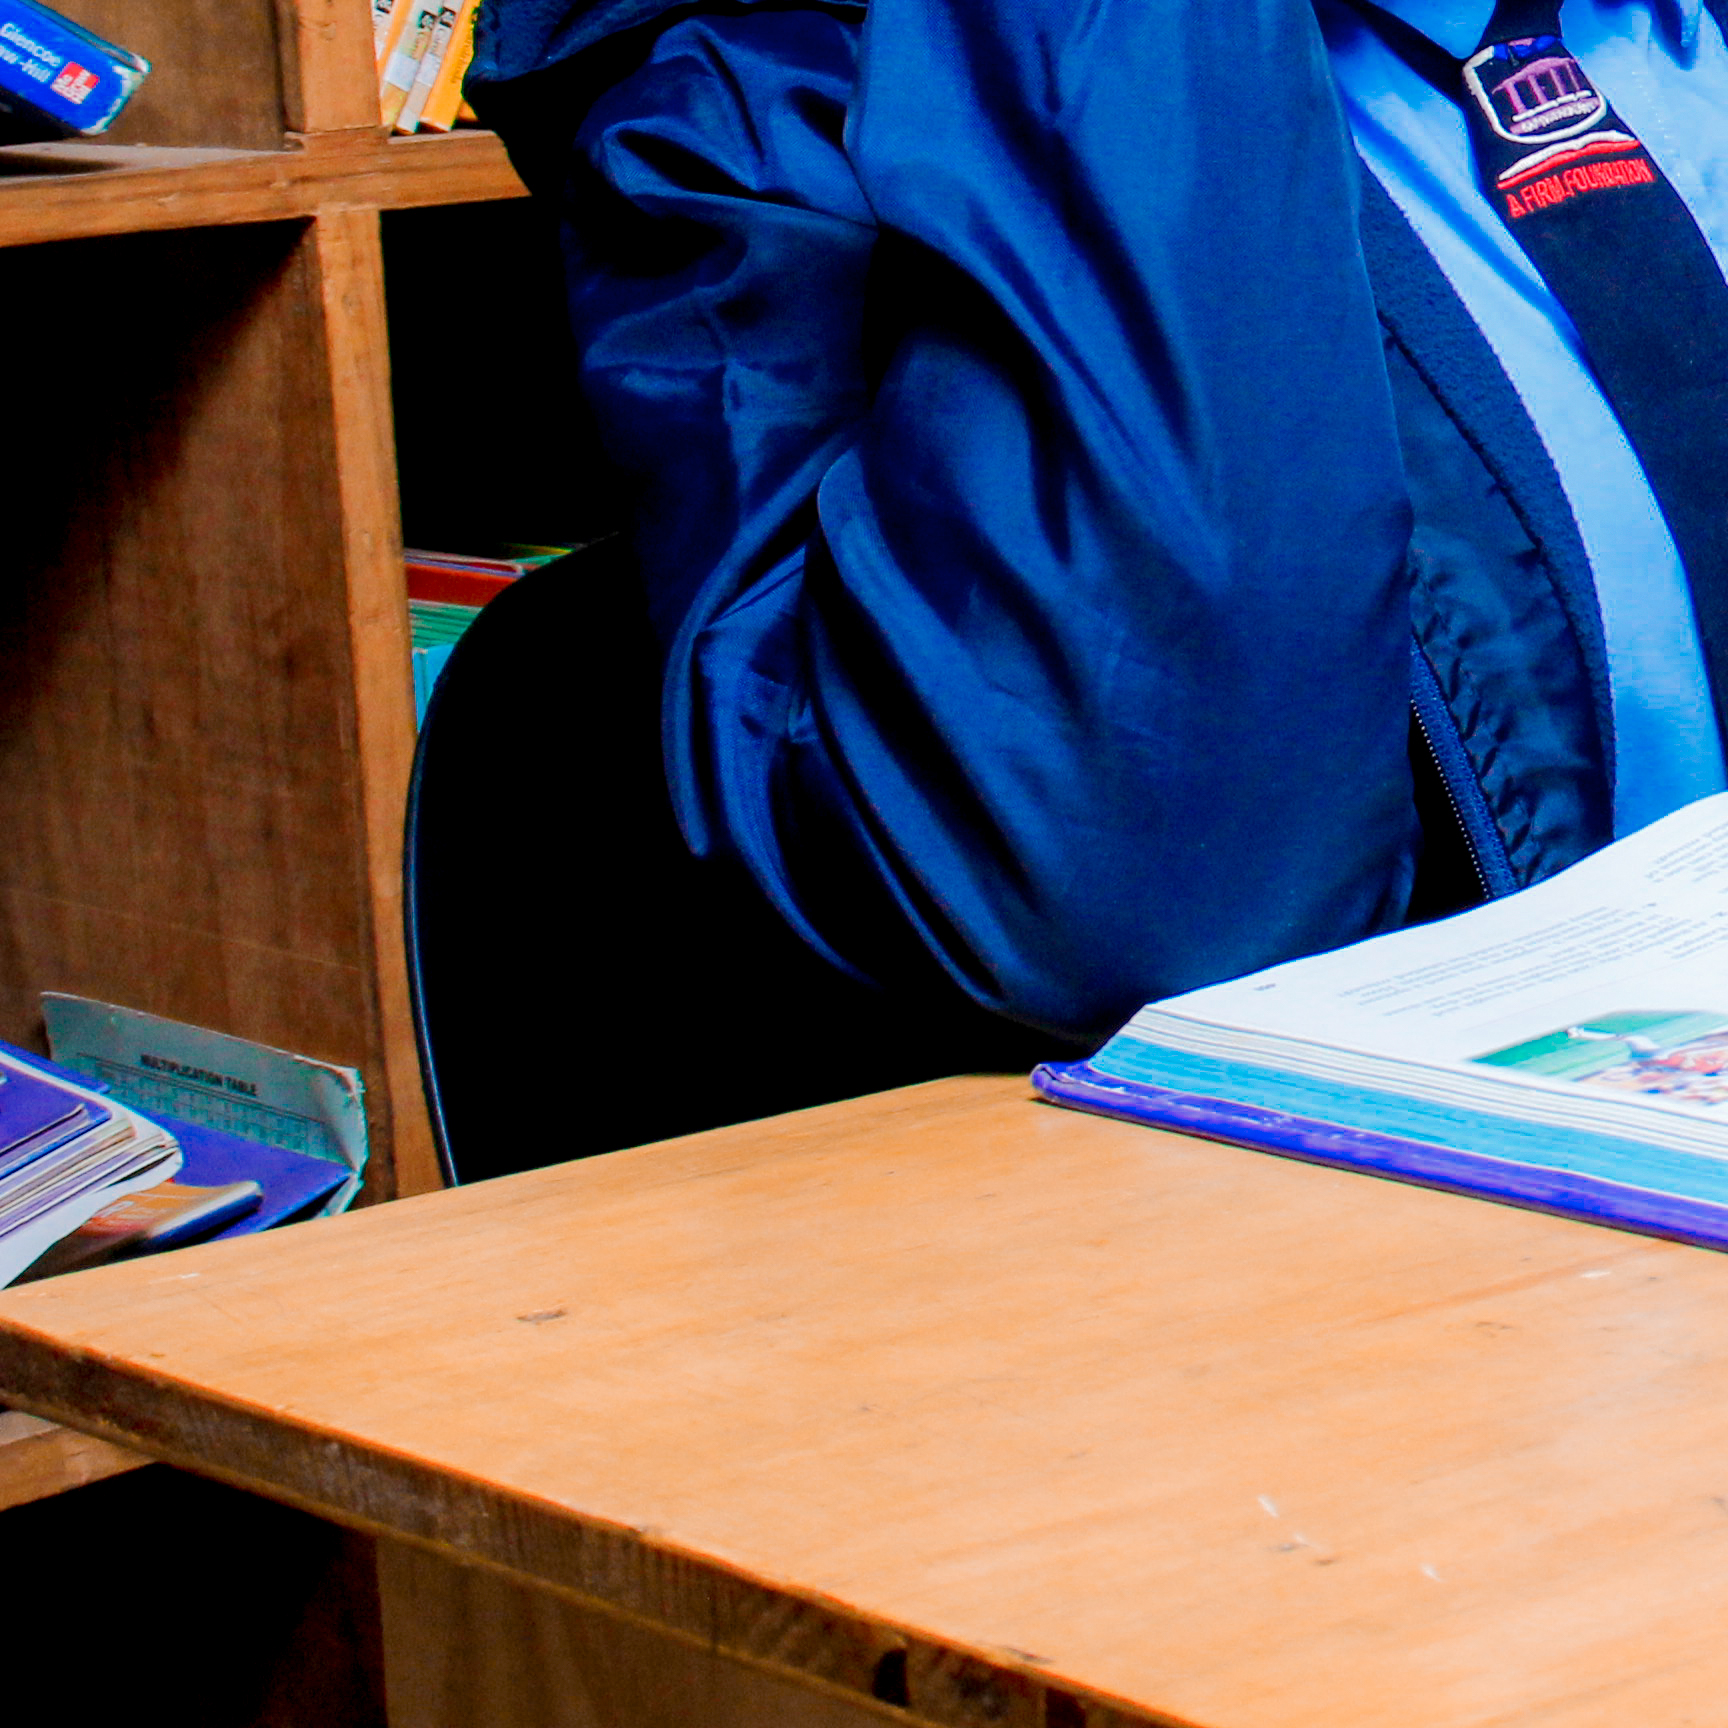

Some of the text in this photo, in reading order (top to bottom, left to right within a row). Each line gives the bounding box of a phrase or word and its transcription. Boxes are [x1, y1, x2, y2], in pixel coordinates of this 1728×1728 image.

[0, 23, 61, 67] Glencoe
[1506, 158, 1655, 219] A FIRM FOUNDATION
[140, 1054, 257, 1097] MULTIPLICATION TABLE
